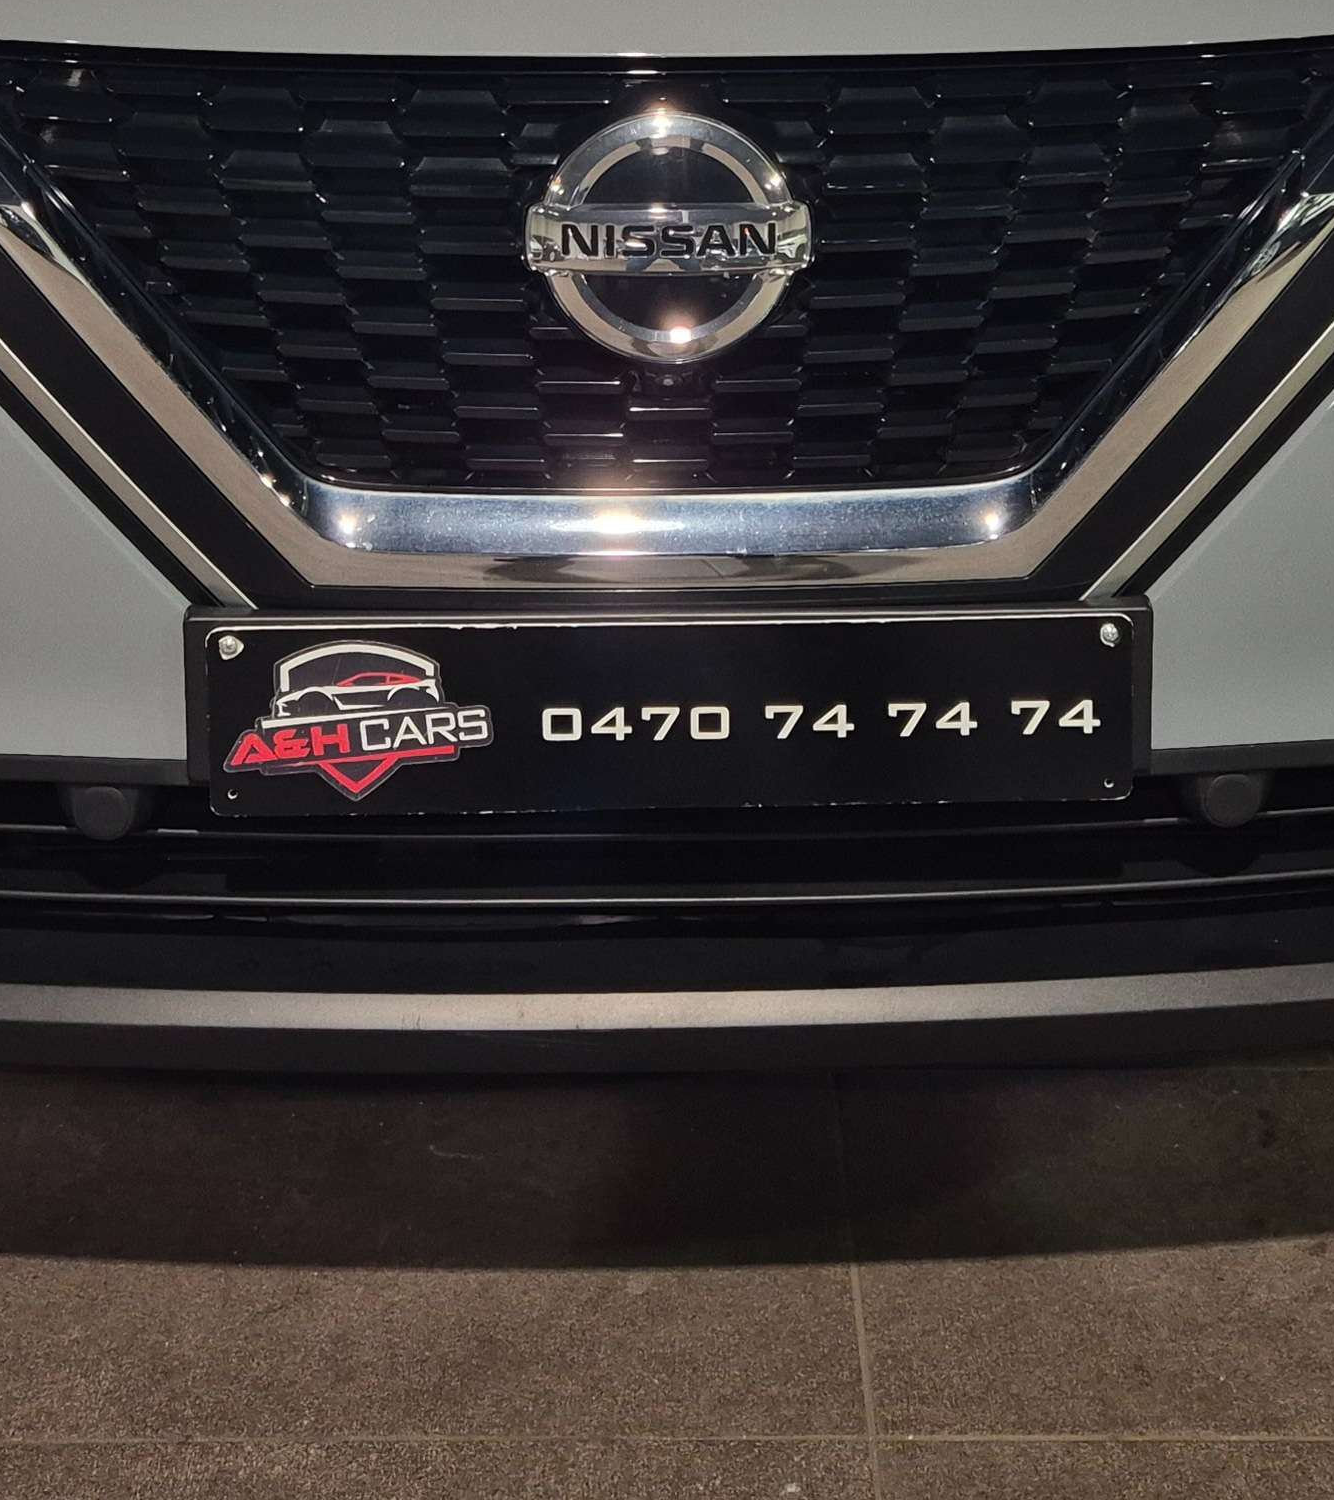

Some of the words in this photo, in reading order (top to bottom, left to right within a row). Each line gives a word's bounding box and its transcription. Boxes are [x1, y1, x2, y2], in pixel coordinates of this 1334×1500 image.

[560, 222, 777, 258] NISSAN
[230, 723, 351, 766] A&H
[359, 709, 490, 751] CARS
[541, 706, 731, 742] 0470
[764, 704, 856, 739] 74
[887, 701, 978, 738] 74
[1010, 699, 1102, 735] 74
